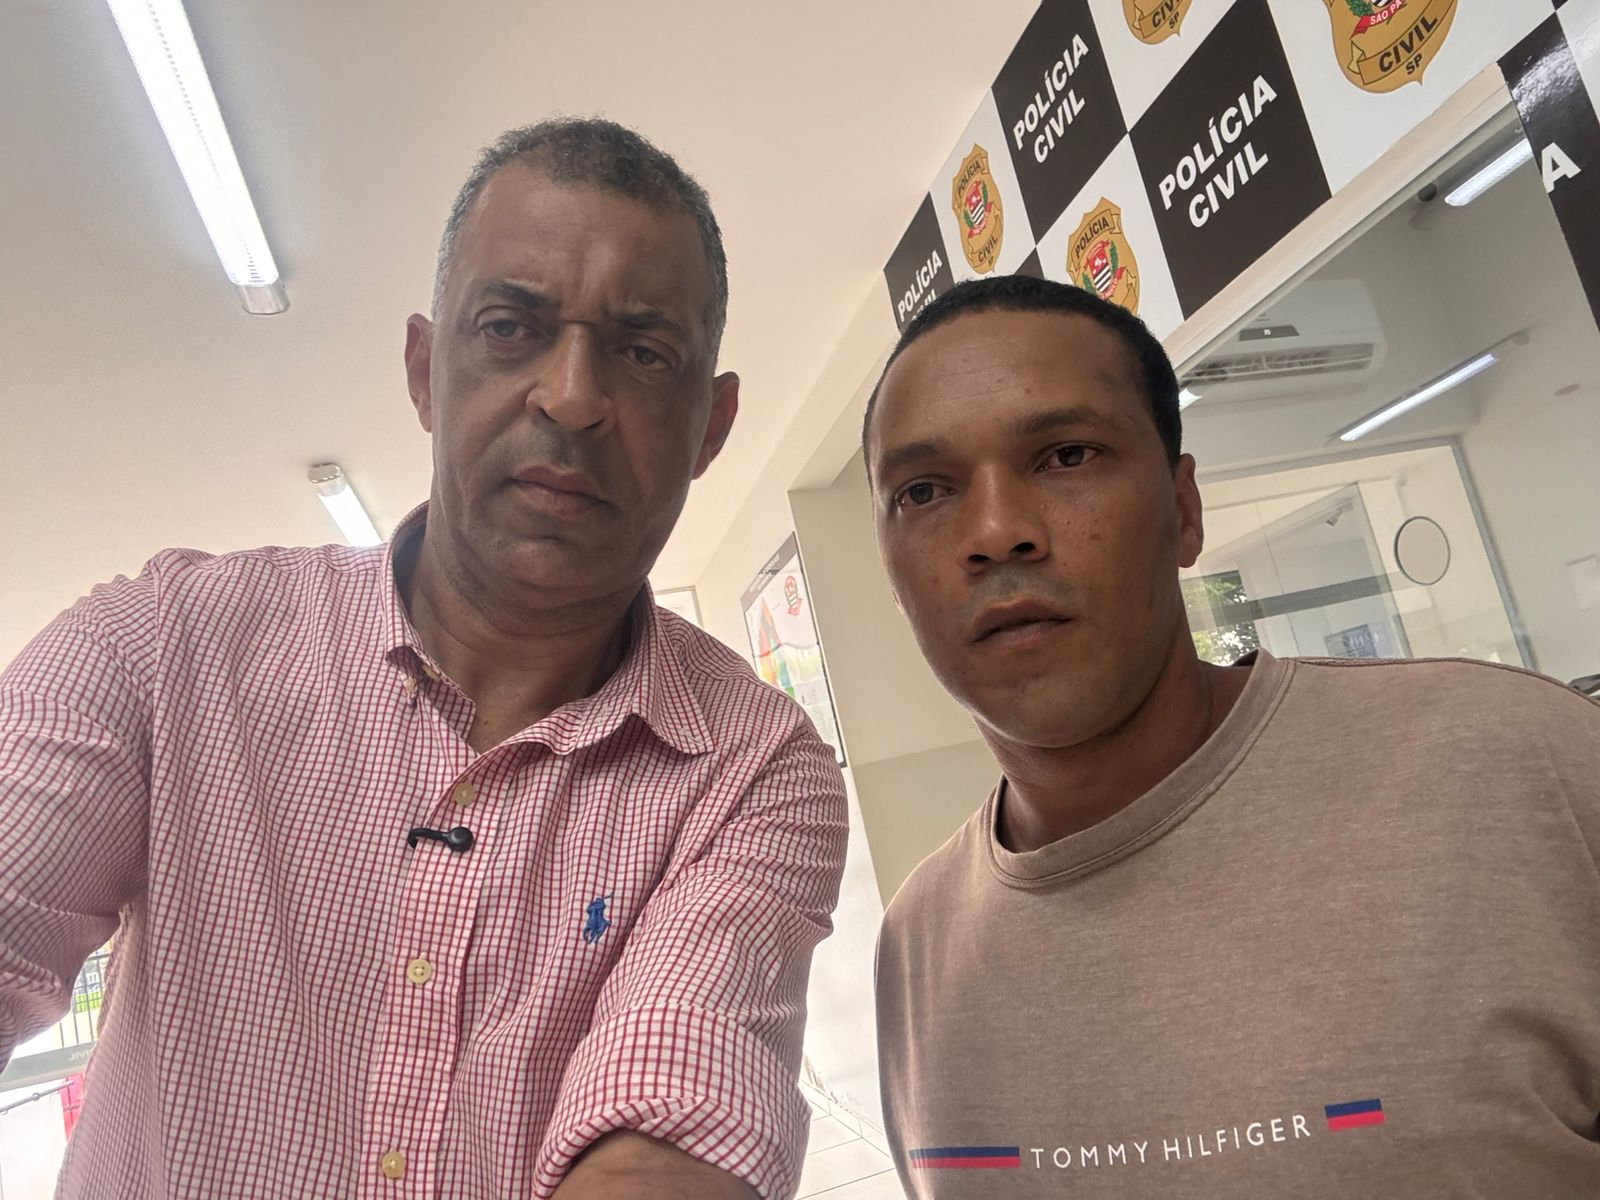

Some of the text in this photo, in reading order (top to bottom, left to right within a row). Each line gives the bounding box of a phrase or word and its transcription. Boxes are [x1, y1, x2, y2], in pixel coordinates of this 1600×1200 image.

[1379, 16, 1439, 73] CIVIL
[1405, 53, 1423, 75] SP
[1012, 34, 1089, 150] POLÍCIA
[1033, 89, 1086, 164] CIVIL
[1158, 75, 1278, 211] POLÍCIA
[1188, 141, 1269, 228] CIVIL
[978, 235, 999, 263] CIVIL
[1074, 216, 1110, 259] POLÍCIA
[897, 249, 943, 323] POLÍCIA
[1030, 1113, 1312, 1169] TOMMY HILFIGER
